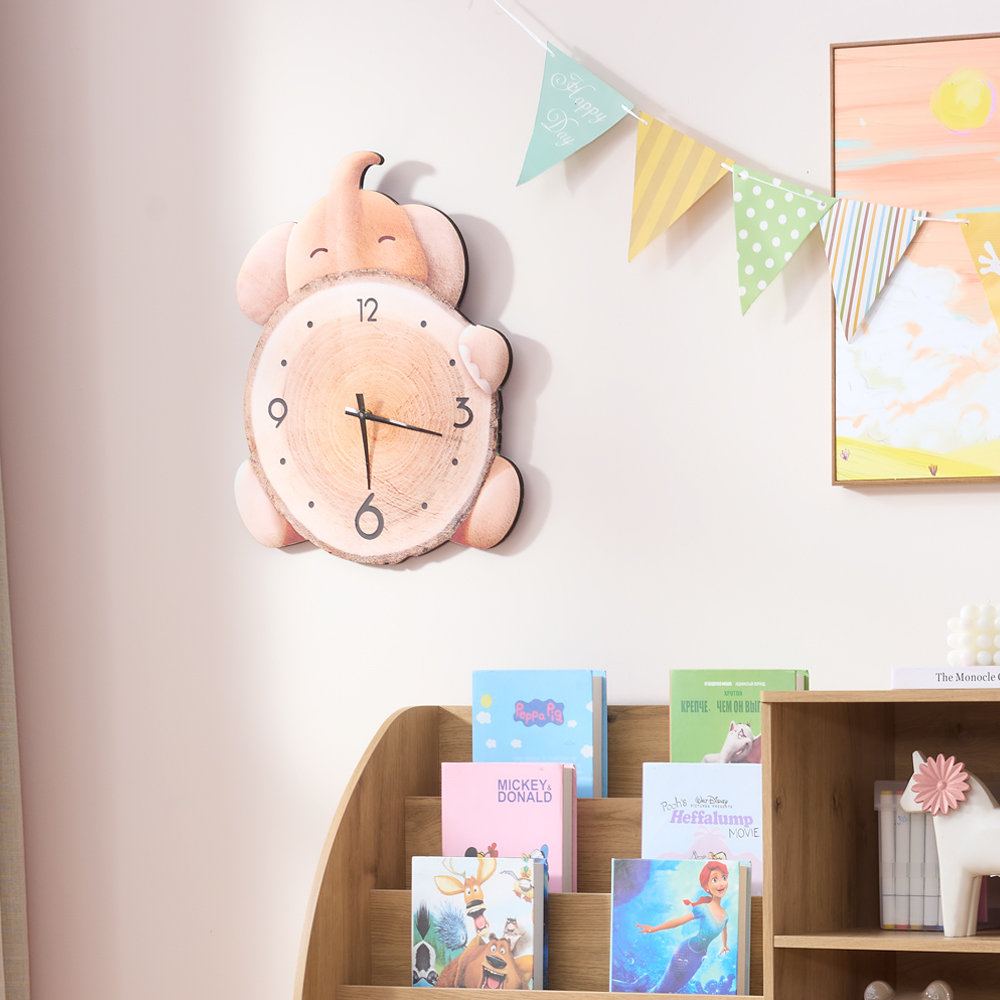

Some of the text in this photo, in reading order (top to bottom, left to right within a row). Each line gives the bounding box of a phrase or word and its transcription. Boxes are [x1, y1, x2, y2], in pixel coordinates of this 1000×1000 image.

[550, 72, 607, 124] Happy
[541, 107, 579, 147] Day
[356, 298, 378, 322] 12
[267, 397, 288, 429] 9
[453, 397, 474, 429] 3
[354, 492, 384, 540] 6
[935, 672, 953, 682] The
[955, 671, 995, 682] Monocle
[516, 702, 564, 724] Peppa Pig
[716, 701, 733, 712] ЧЕМ
[734, 701, 744, 712] ОН
[497, 791, 552, 803] DONALD
[670, 809, 754, 827] Heffalump
[728, 827, 760, 838] MOVIE
